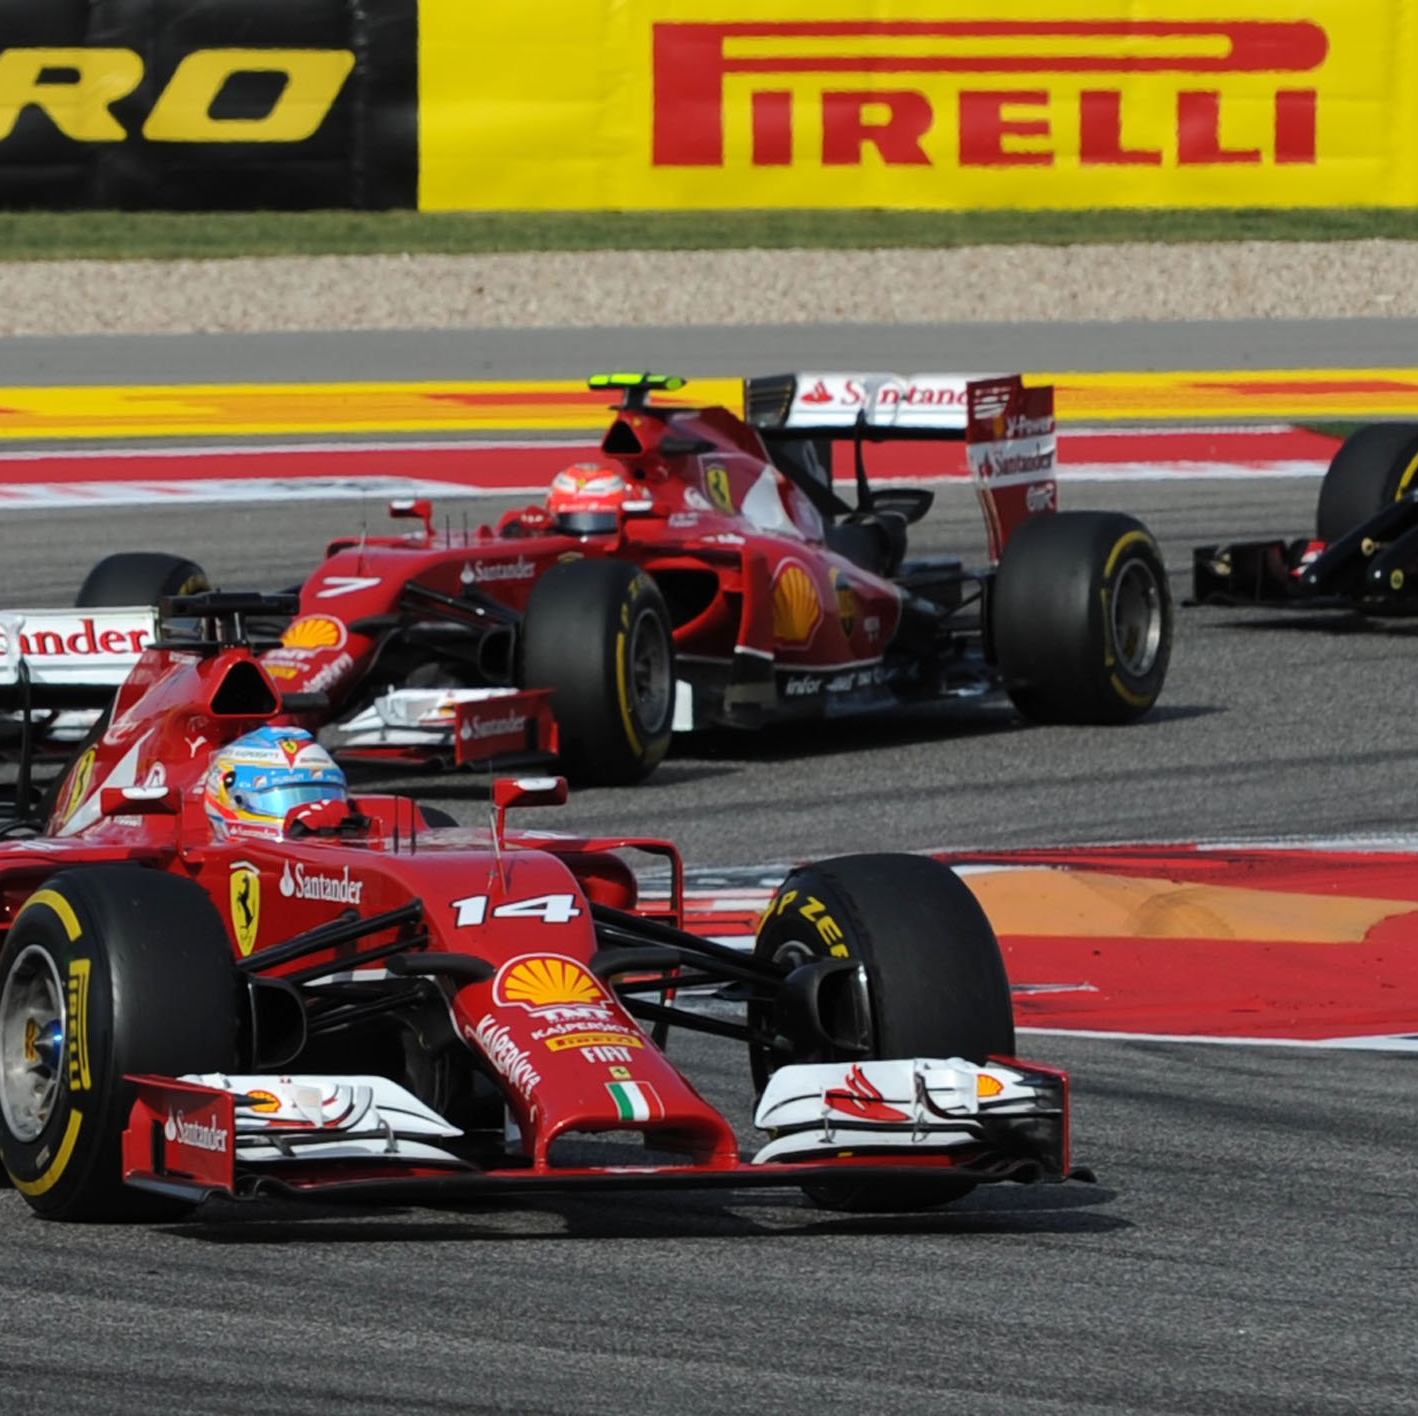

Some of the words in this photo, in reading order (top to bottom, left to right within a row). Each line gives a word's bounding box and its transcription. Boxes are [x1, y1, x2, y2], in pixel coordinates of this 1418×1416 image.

[651, 18, 1330, 168] PIRELLI
[840, 379, 967, 407] Sntan
[474, 555, 536, 583] Santander
[316, 576, 382, 598] 7
[470, 709, 527, 739] Santander
[294, 862, 364, 904] Santander
[451, 893, 581, 928] 14
[777, 889, 799, 916] P
[67, 958, 92, 1091] PIRELLI
[530, 1022, 629, 1040] KASPERSKY
[580, 1046, 633, 1063] FIAT
[176, 1110, 229, 1154] Santander
